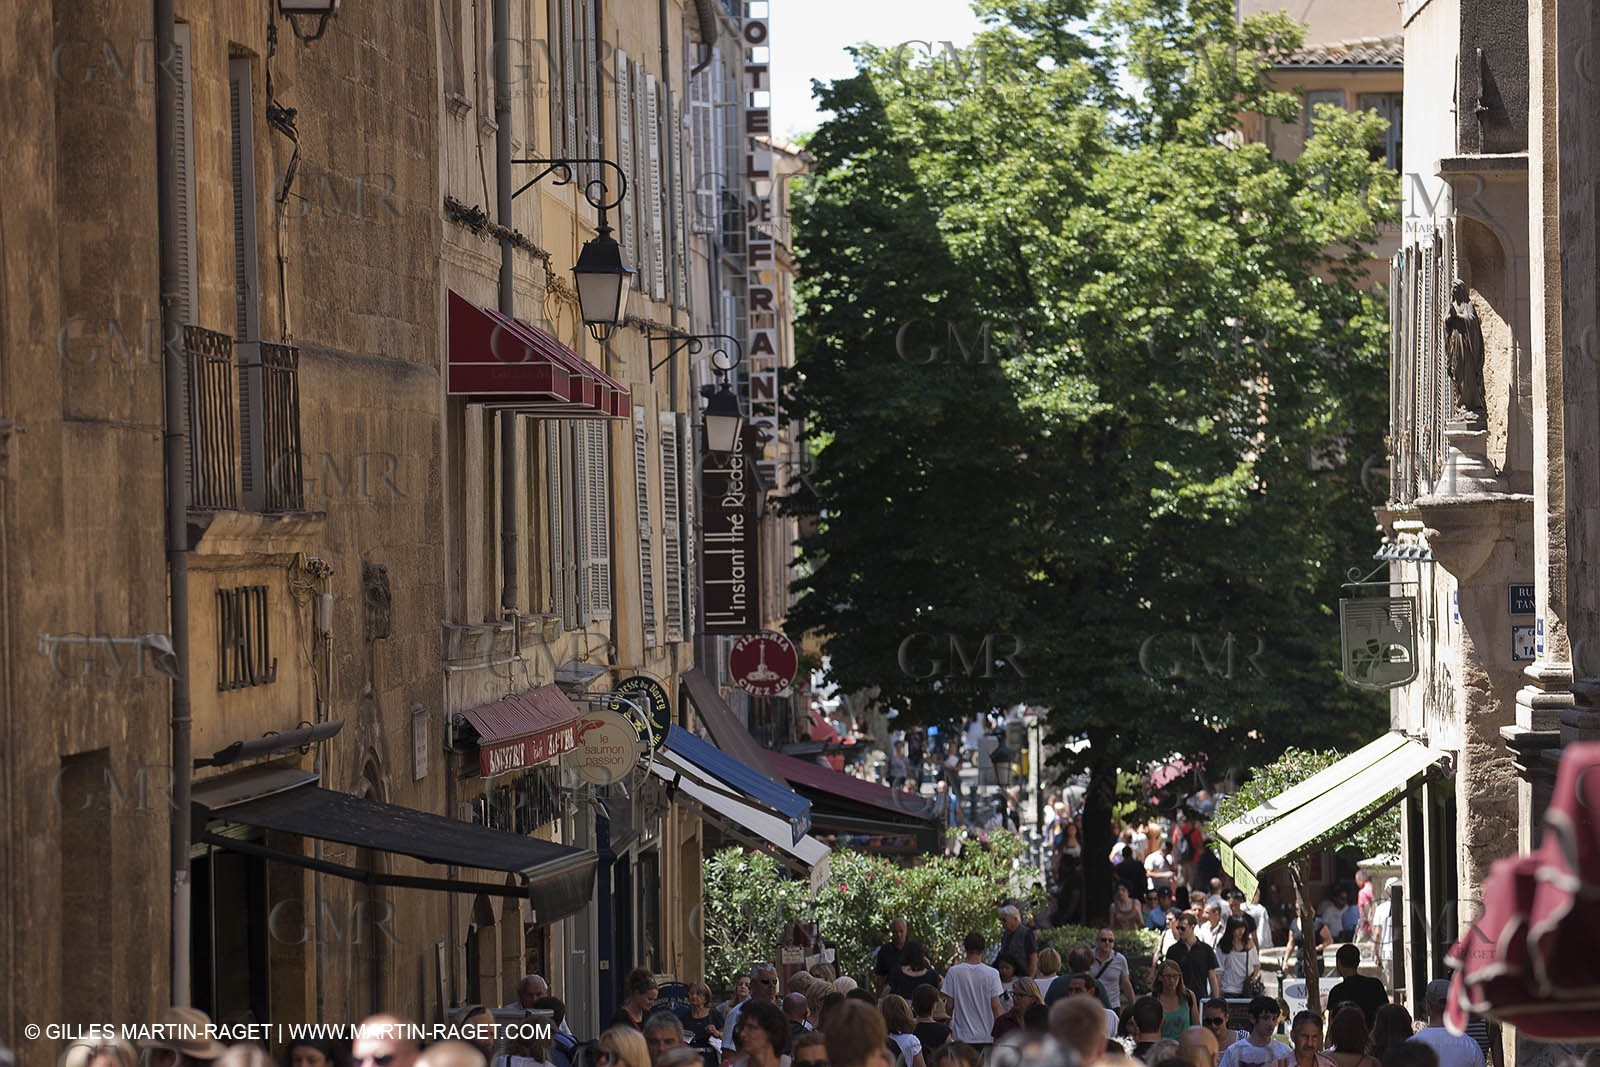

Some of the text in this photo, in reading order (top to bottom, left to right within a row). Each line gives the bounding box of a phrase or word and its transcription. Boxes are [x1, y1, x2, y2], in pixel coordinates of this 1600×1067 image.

[748, 200, 772, 222] DE
[704, 513, 745, 543] thé
[704, 549, 746, 625] L'instant
[739, 678, 789, 695] CHEZ JO
[648, 683, 667, 711] Barry
[600, 733, 609, 744] le
[584, 746, 625, 755] saumon
[585, 756, 624, 767] passion
